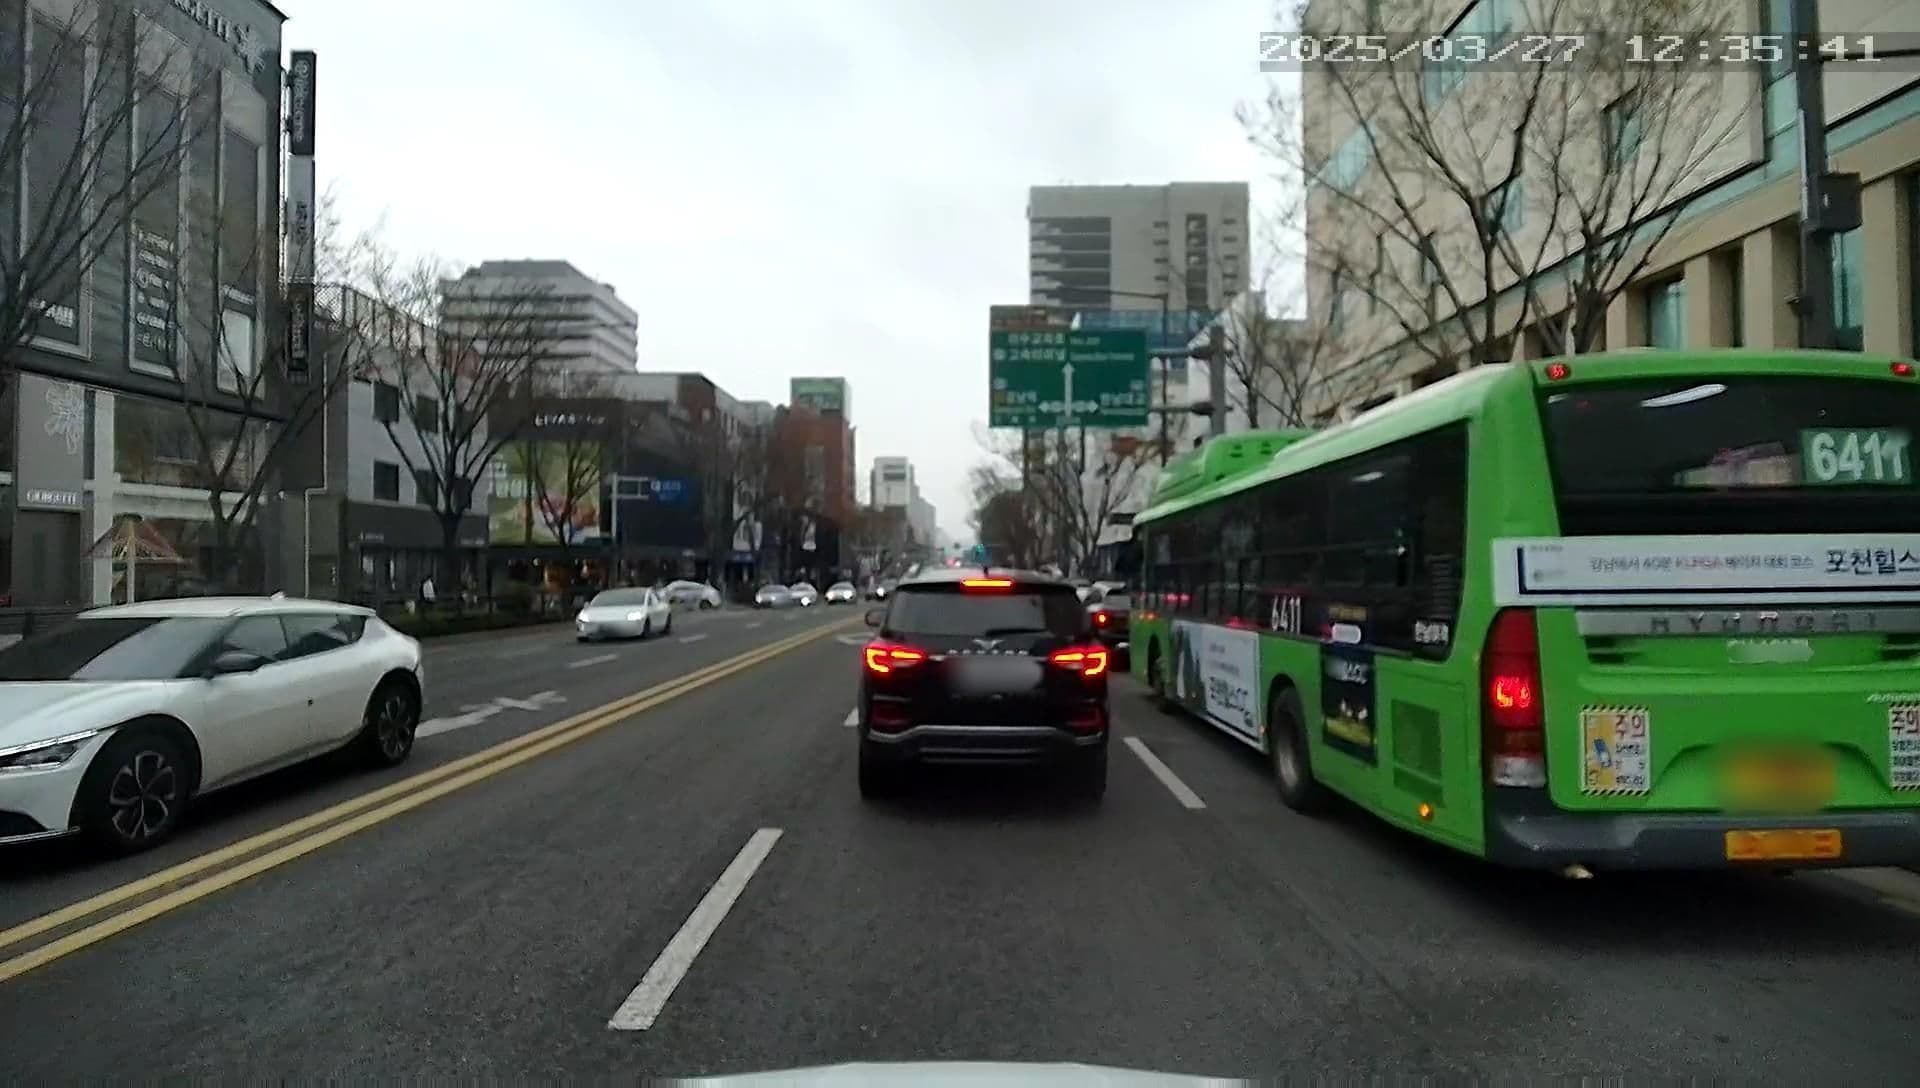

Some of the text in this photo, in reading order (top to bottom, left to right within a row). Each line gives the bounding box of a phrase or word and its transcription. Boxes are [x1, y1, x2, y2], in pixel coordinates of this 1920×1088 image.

[1811, 432, 1904, 482] 6411
[1825, 547, 1920, 576] 포천힐스
[1271, 595, 1302, 636] 6411
[1615, 714, 1646, 740] 주의
[1891, 709, 1920, 736] 주의
